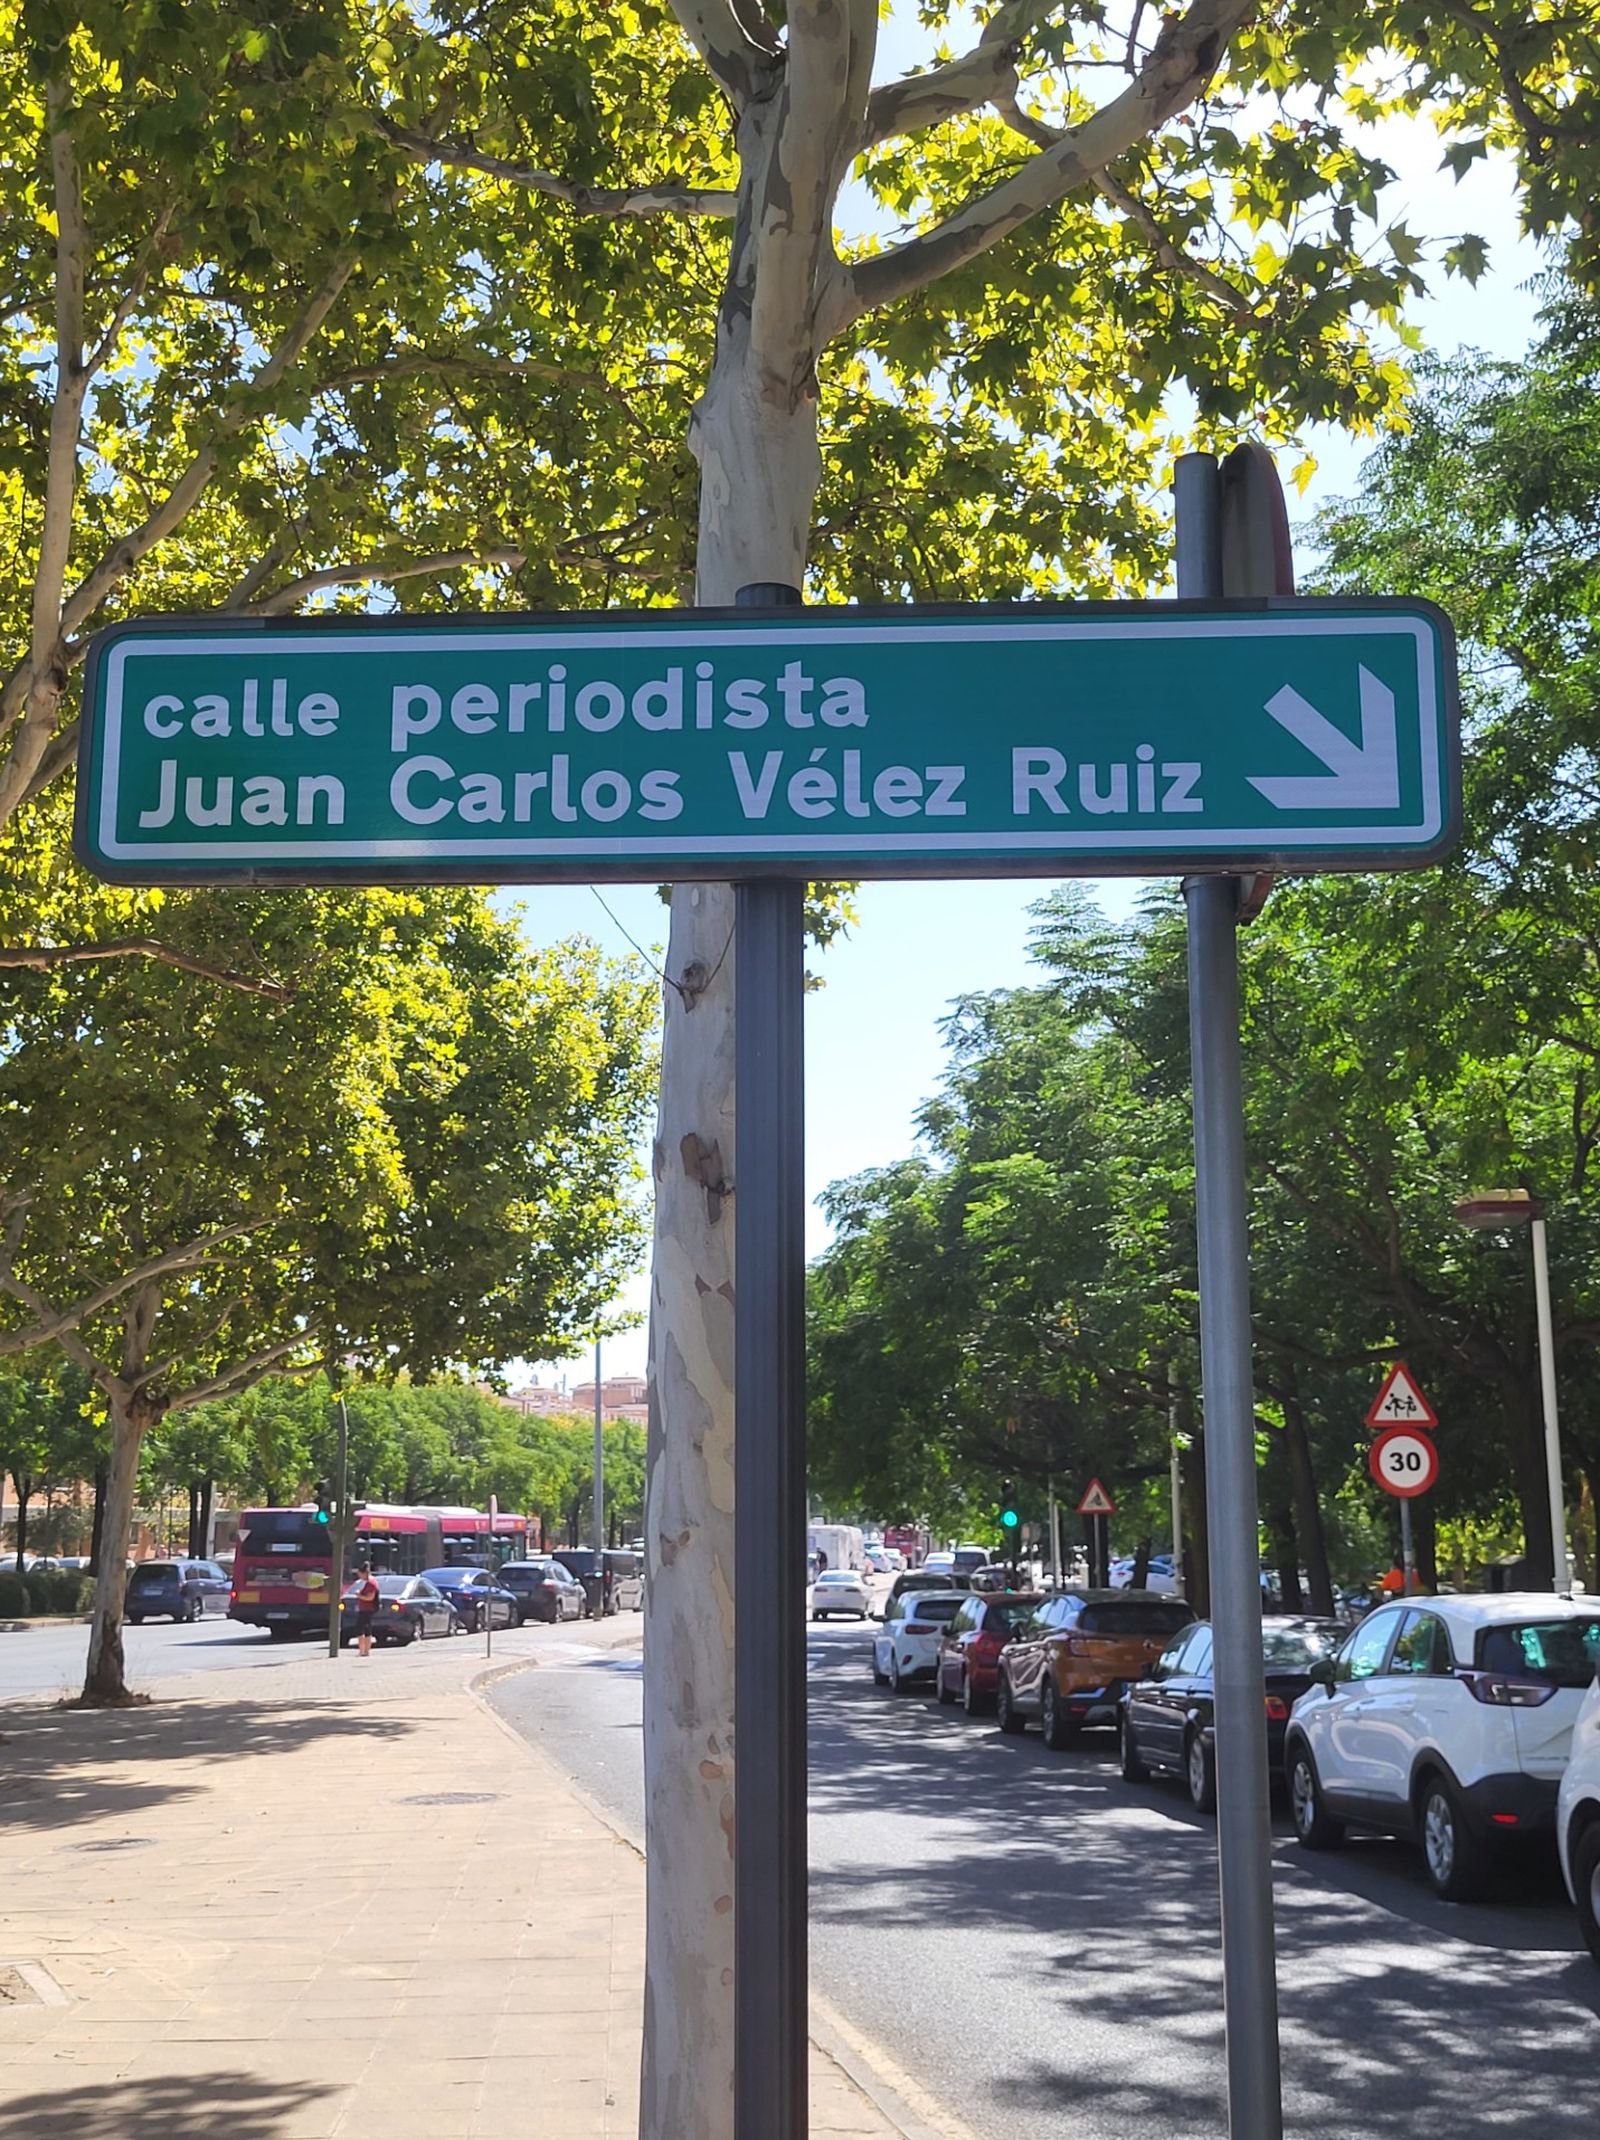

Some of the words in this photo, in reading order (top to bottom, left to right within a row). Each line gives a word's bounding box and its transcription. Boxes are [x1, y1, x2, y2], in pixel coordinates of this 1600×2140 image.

[143, 677, 340, 738] calle
[391, 662, 868, 753] periodista
[138, 759, 346, 829] Juan
[389, 753, 684, 825] Carlos
[727, 746, 967, 819] Vélez
[1012, 743, 1204, 815] Ruiz
[1389, 1452, 1421, 1472] 30
